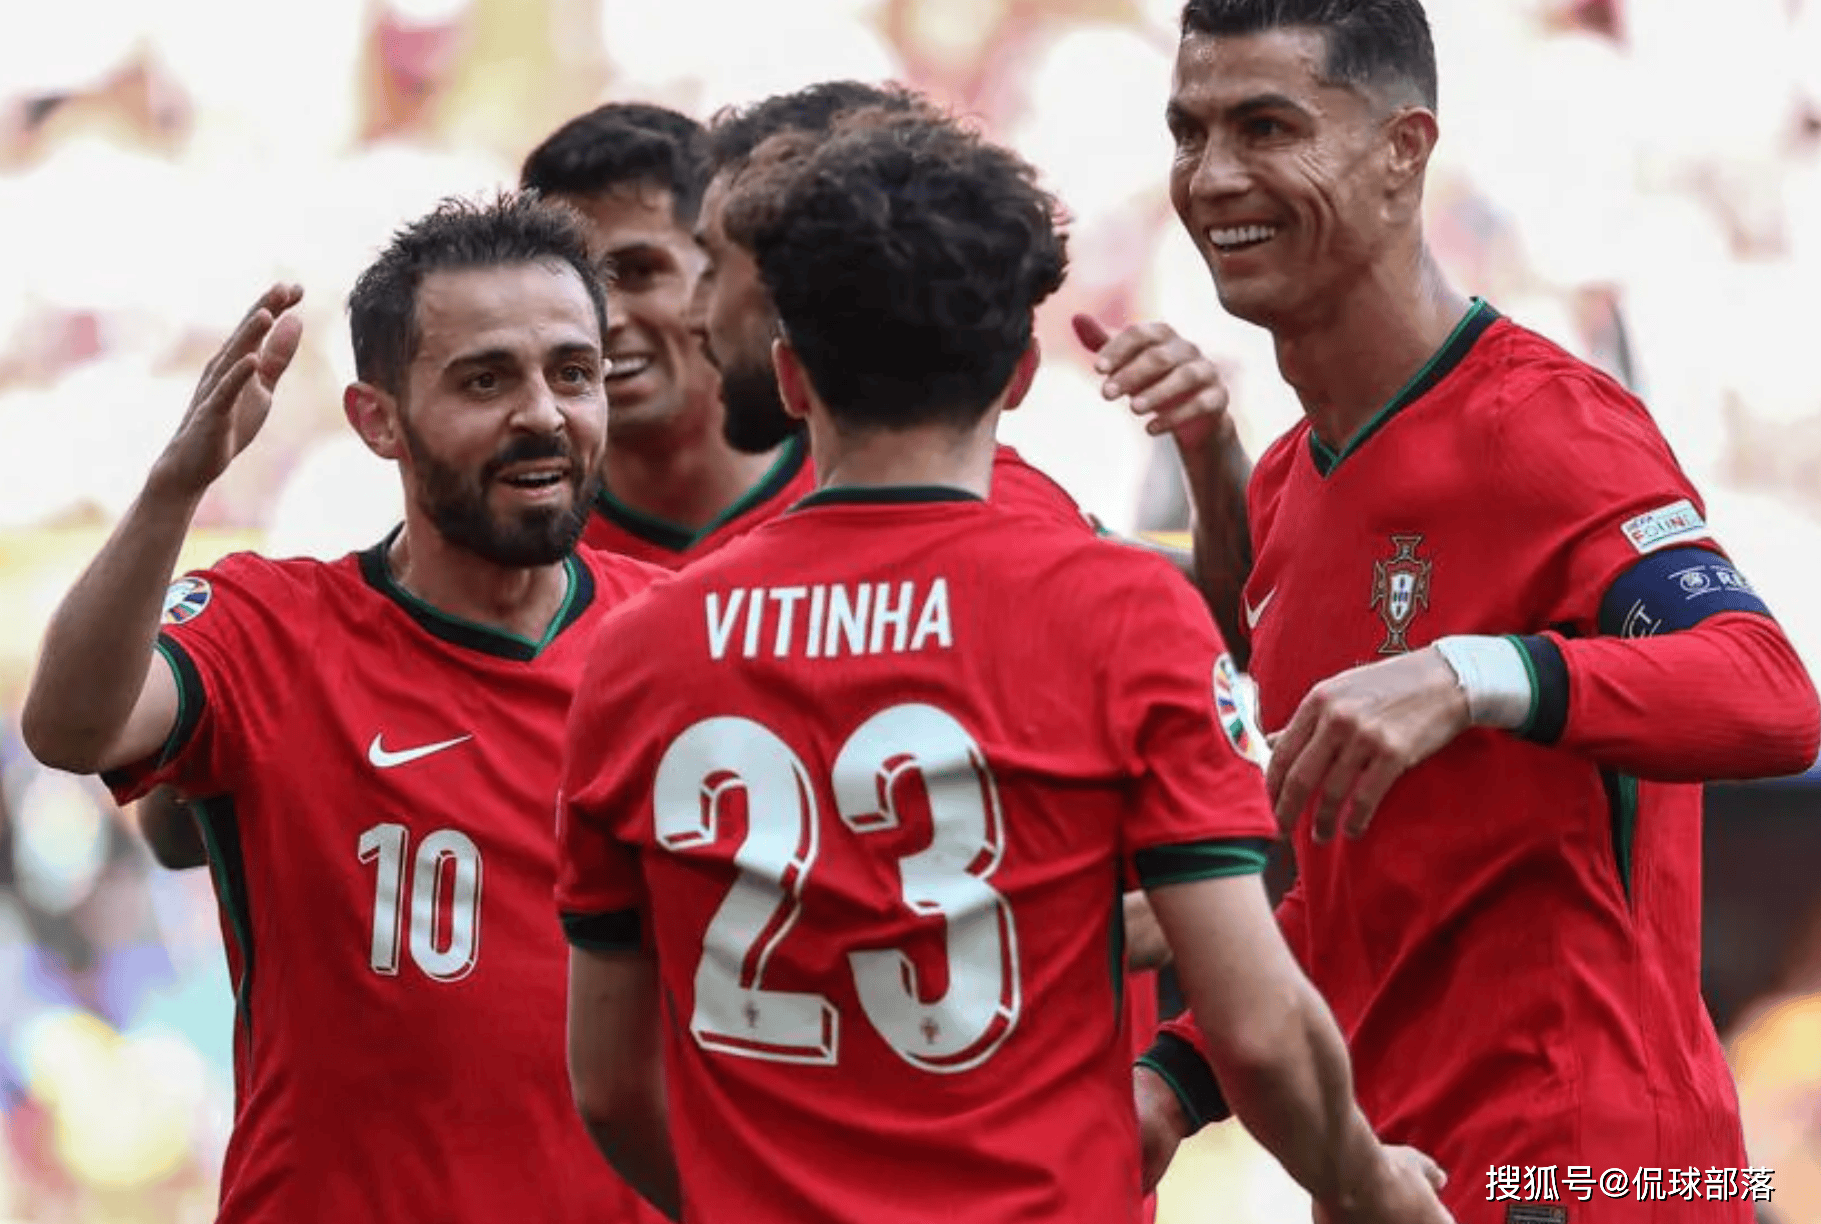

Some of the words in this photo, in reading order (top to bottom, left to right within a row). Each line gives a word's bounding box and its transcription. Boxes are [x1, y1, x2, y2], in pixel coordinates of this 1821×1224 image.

[705, 578, 952, 659] VITINHA
[358, 823, 482, 982] 10
[653, 703, 1021, 1074] 23
